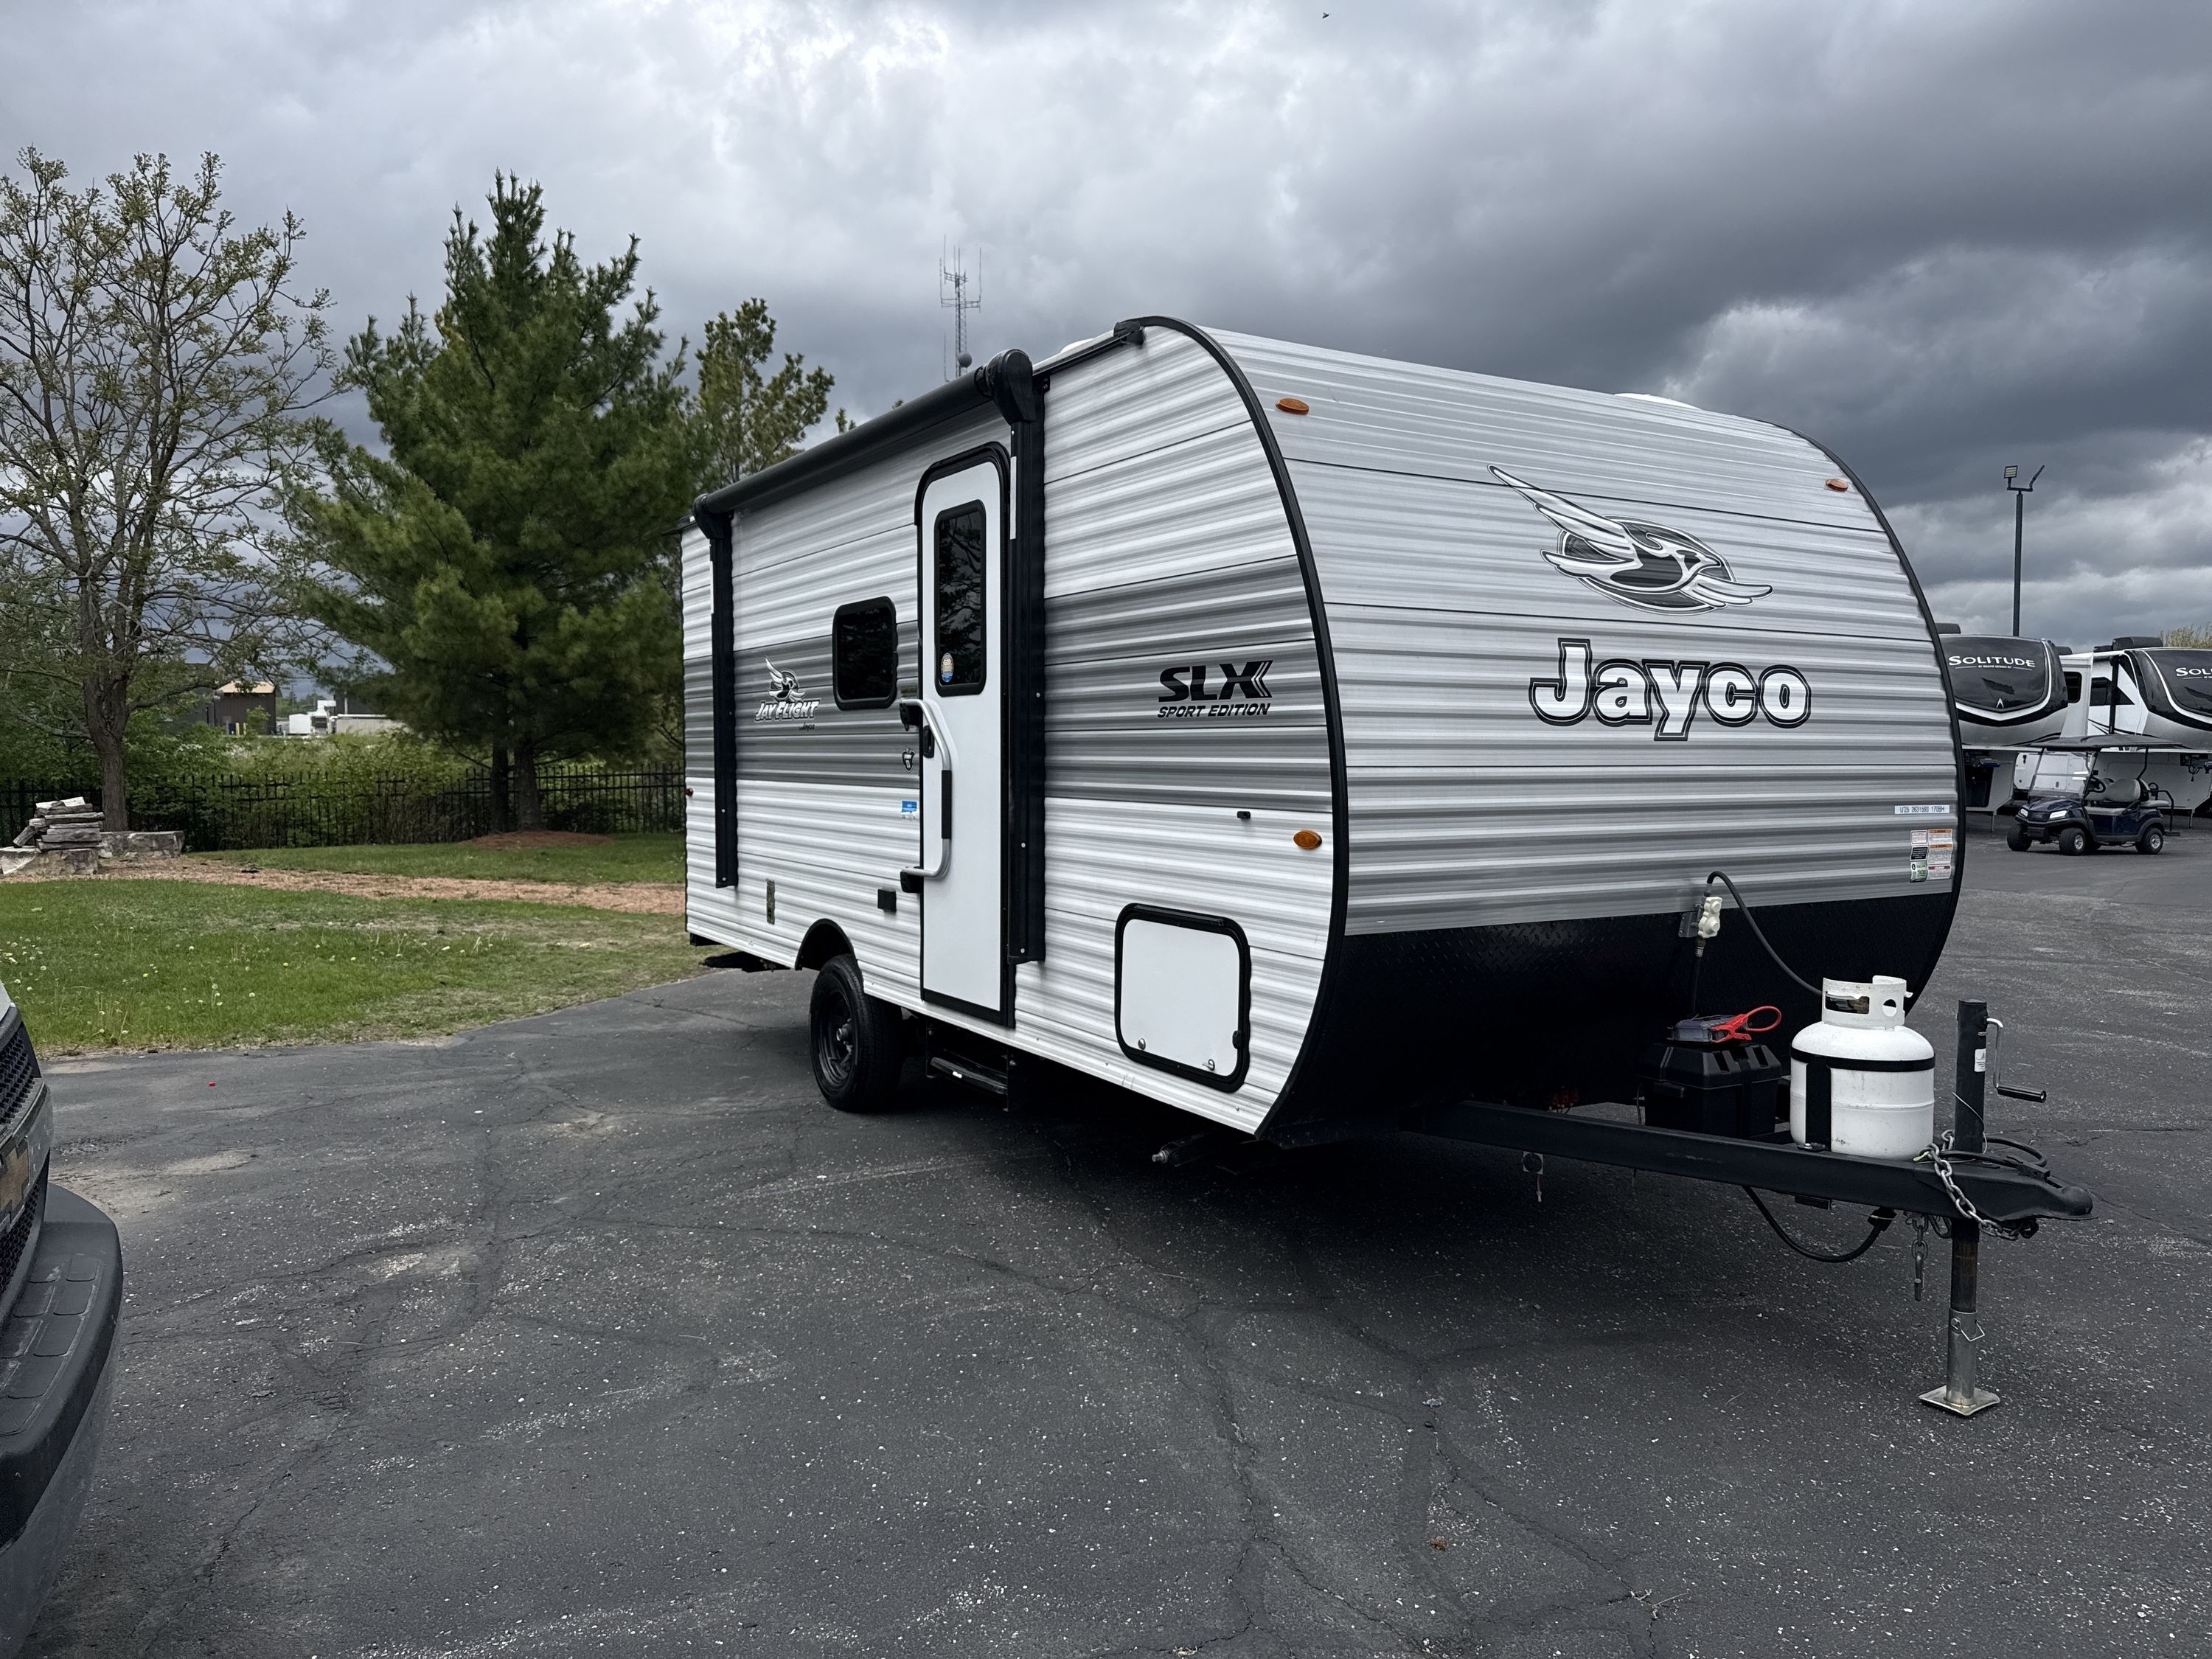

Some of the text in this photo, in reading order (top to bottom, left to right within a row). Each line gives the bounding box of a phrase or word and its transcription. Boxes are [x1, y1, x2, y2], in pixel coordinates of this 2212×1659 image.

[1949, 655, 2036, 668] SOLITUDE
[1158, 660, 1273, 702] SLX
[1528, 638, 1812, 741] Jayco
[755, 698, 821, 722] JAY FLIGHT
[1157, 703, 1271, 718] SPORT EDITION
